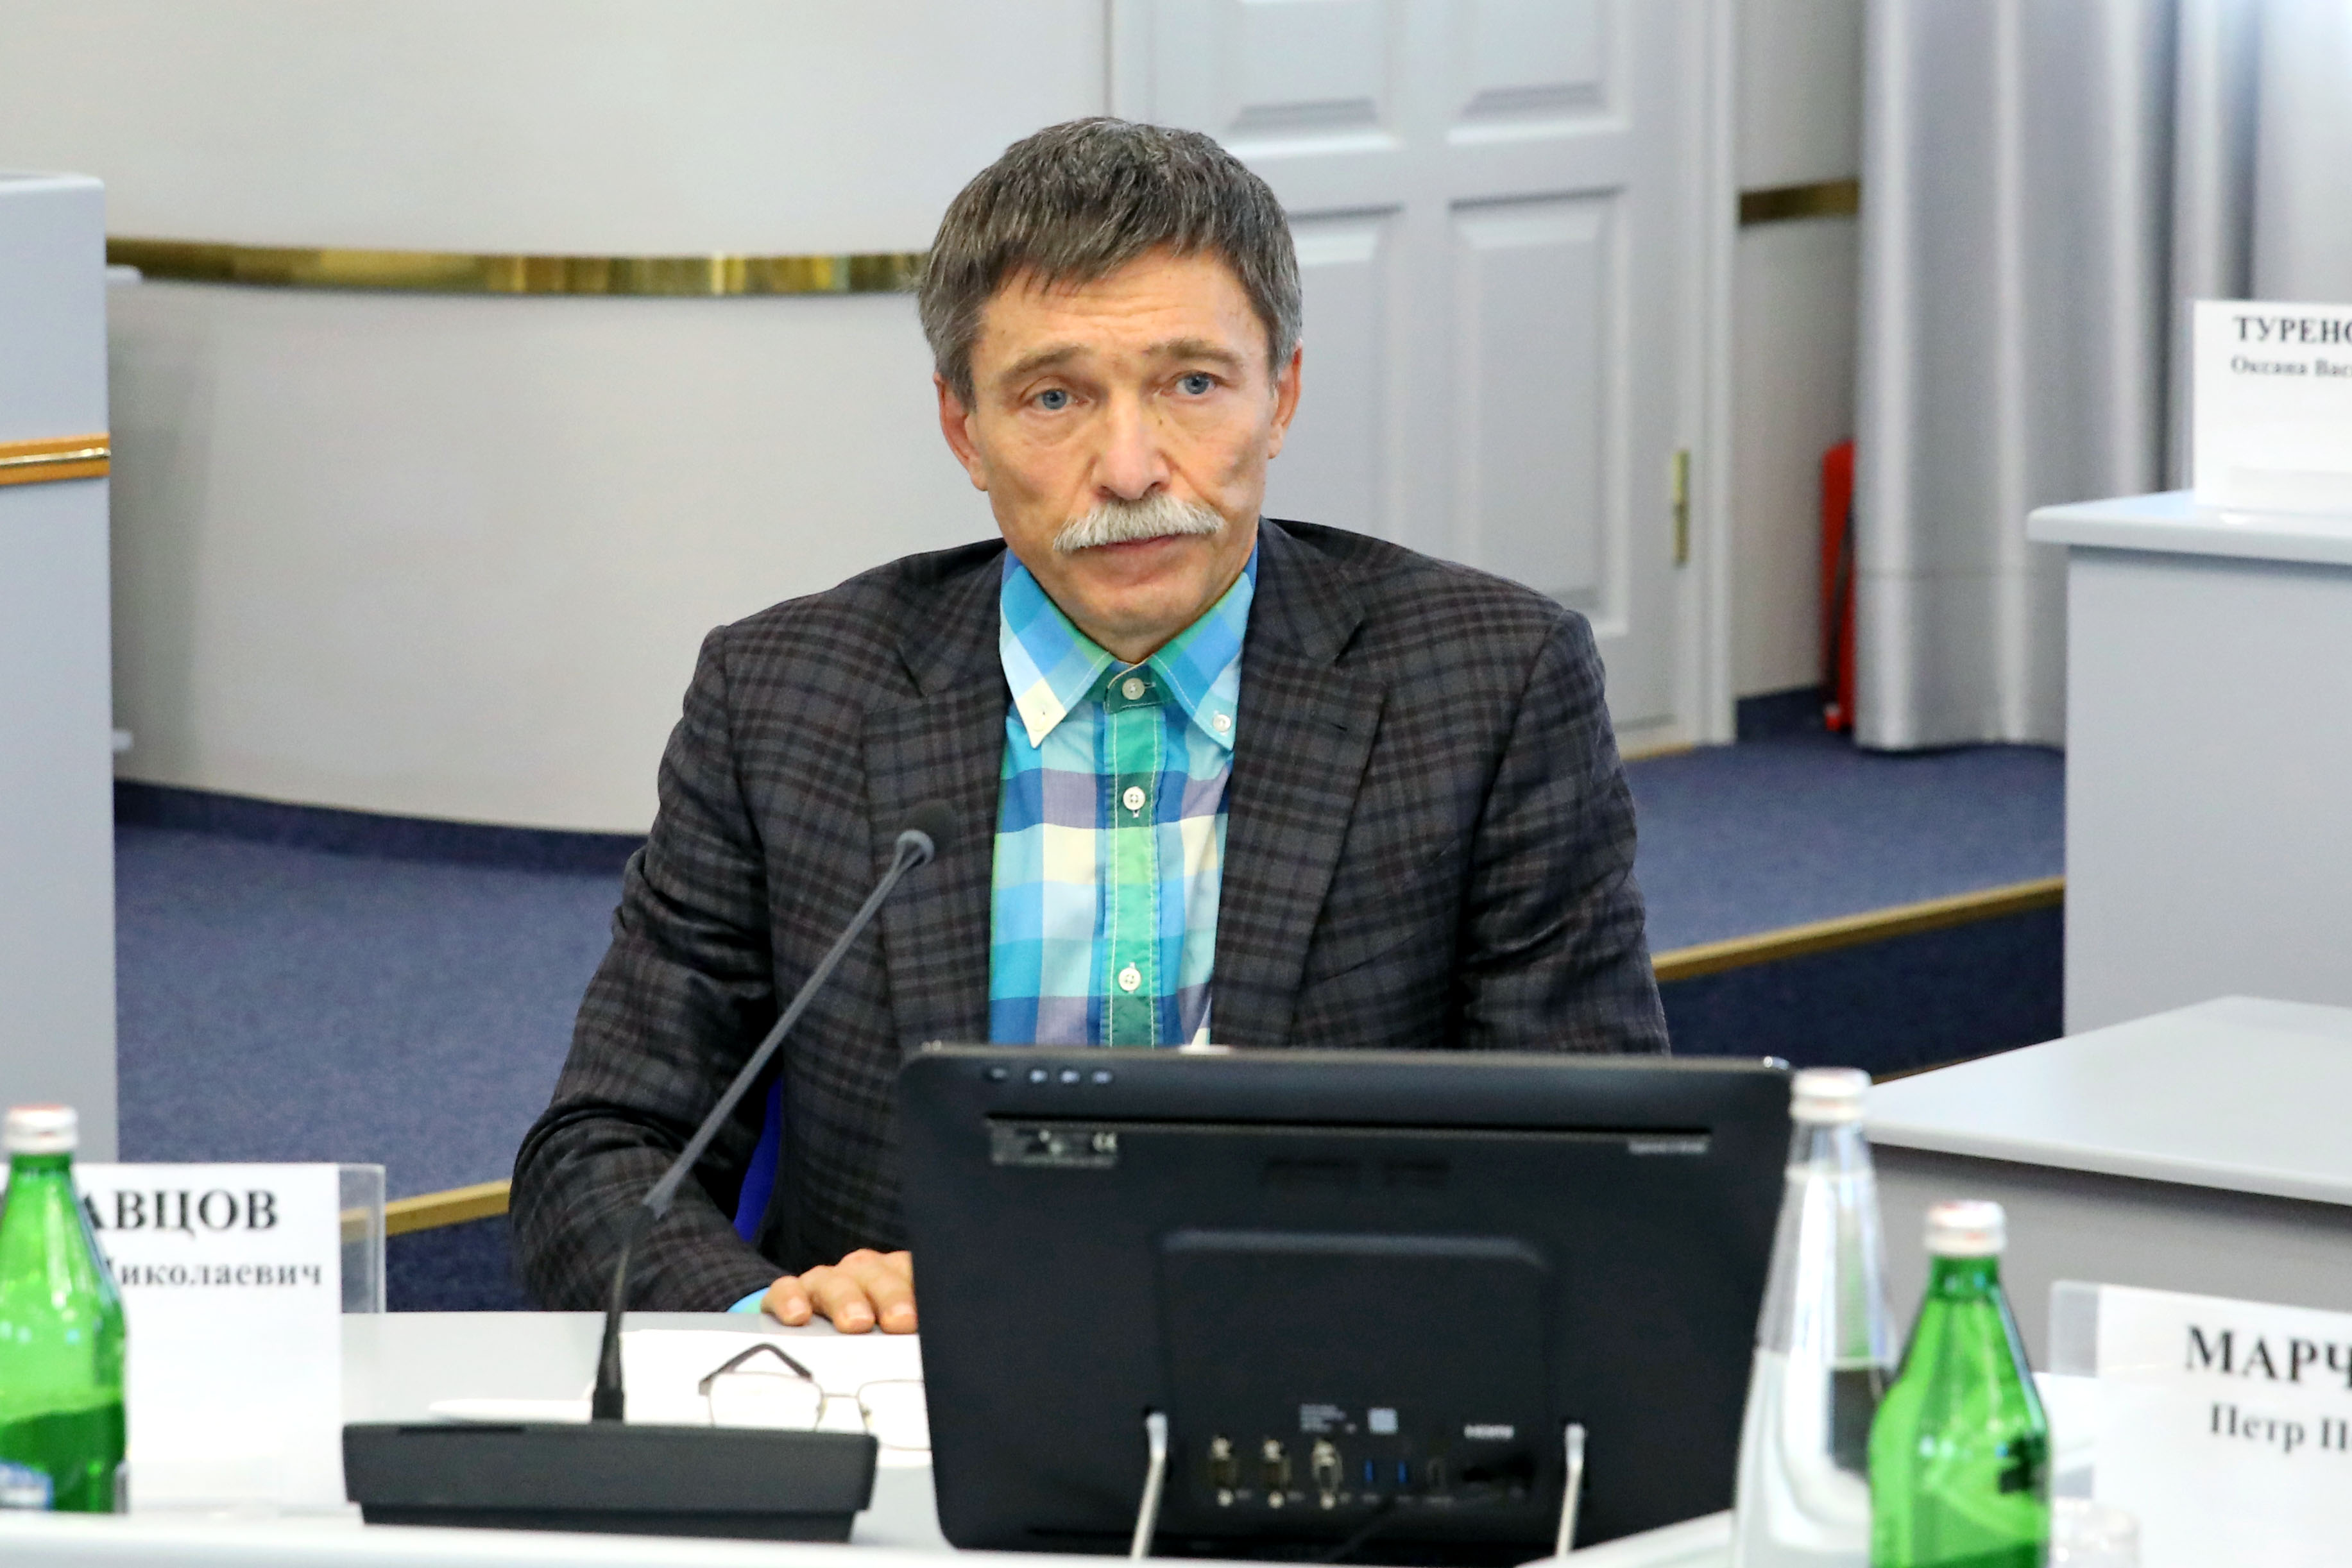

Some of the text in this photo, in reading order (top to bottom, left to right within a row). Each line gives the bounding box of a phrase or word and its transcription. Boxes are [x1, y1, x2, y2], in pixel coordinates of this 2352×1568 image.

[2229, 355, 2308, 375] Оксана
[105, 1256, 322, 1286] иколаевич
[2184, 1323, 2352, 1391] МАРЧ
[2210, 1401, 2306, 1454] Петр
